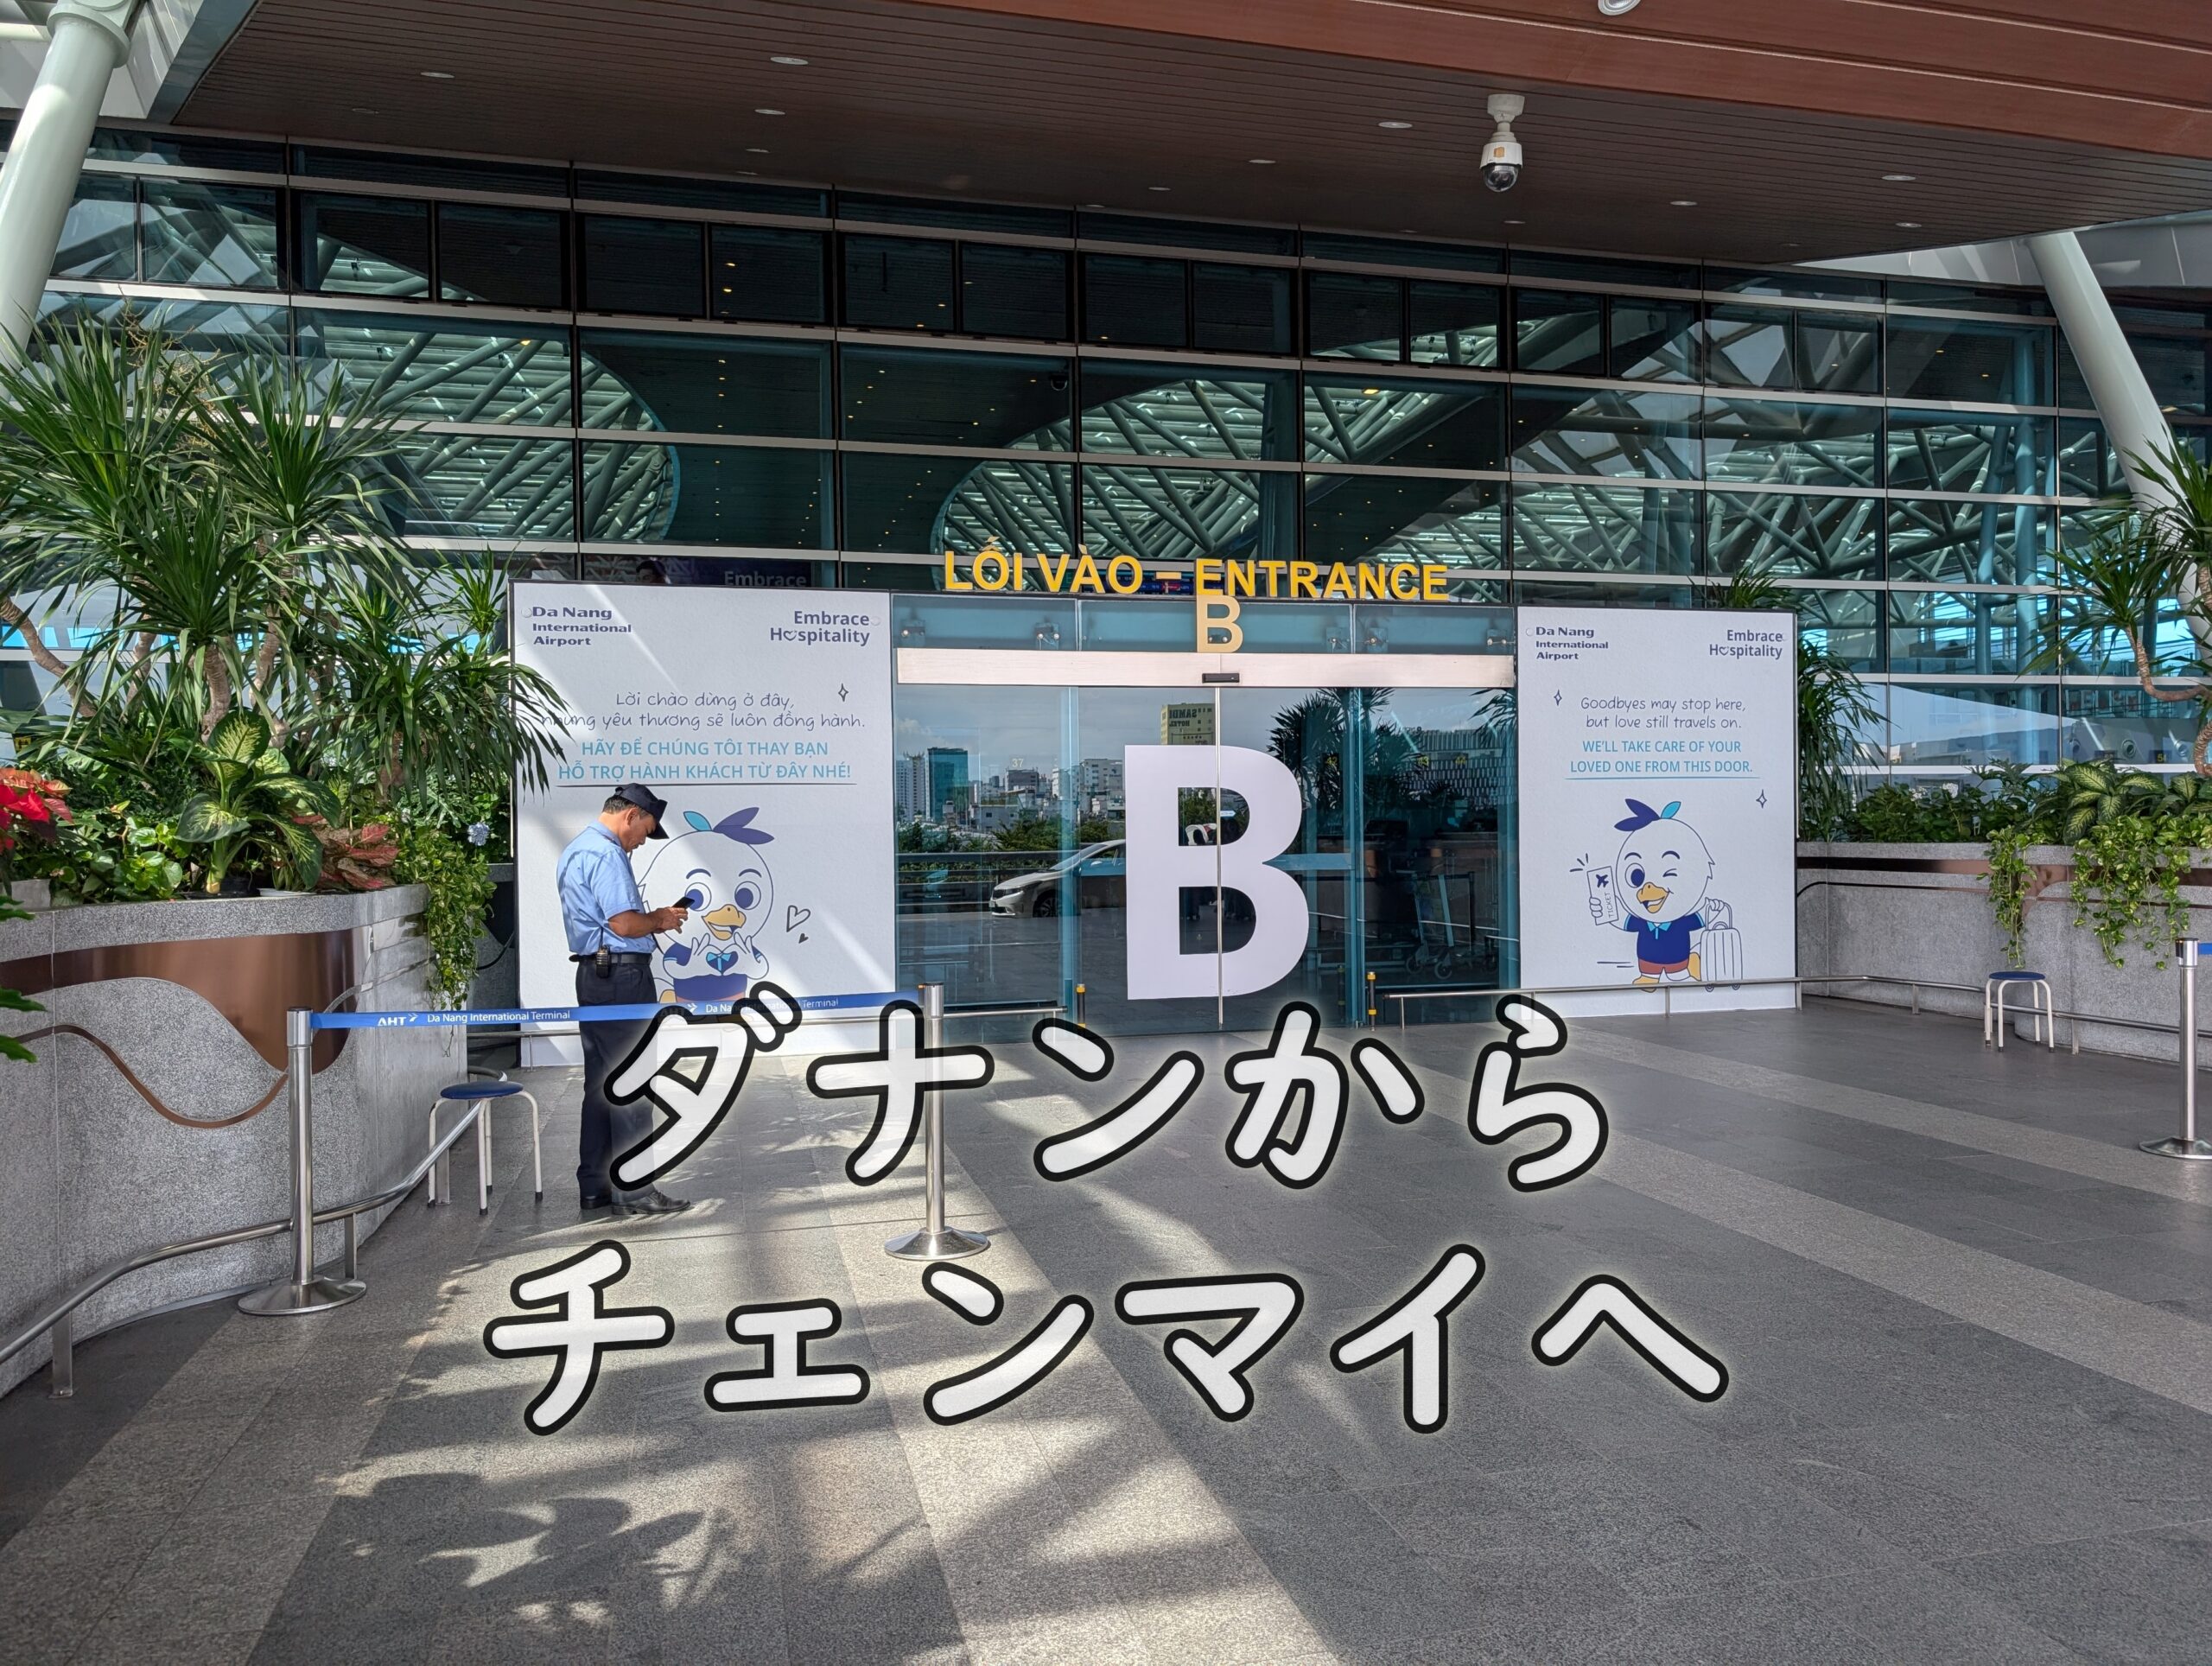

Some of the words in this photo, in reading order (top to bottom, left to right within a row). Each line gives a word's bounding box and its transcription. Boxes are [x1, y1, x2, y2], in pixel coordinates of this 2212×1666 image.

[945, 537, 1023, 591] LỐI
[1037, 544, 1143, 595] VÀO
[1196, 558, 1449, 601] ENTRANCE
[532, 607, 558, 617] Da
[563, 607, 613, 620] Nang
[794, 610, 870, 626] Embrace
[532, 623, 632, 633] International
[1197, 595, 1243, 653] B
[1535, 626, 1555, 636] Da
[1558, 627, 1595, 638] Nang
[1726, 629, 1783, 642] Embrace
[533, 636, 592, 646] Airport
[1535, 640, 1609, 649] International
[1536, 652, 1580, 661] Airport
[616, 691, 640, 705] Lời
[647, 692, 689, 706] chào
[695, 692, 737, 711] dừng
[743, 692, 754, 707] ở
[760, 693, 794, 711] đây,
[1580, 696, 1645, 713] Goodbyes
[1651, 700, 1676, 712] may
[1681, 697, 1711, 711] stop
[1715, 697, 1746, 712] here,
[602, 713, 632, 729] yêu
[639, 712, 700, 730] thương
[706, 713, 723, 727] sẽ
[731, 713, 767, 727] luôn
[773, 710, 815, 731] đồng
[821, 714, 865, 728] hành.
[1586, 715, 1609, 728] but
[1615, 715, 1640, 728] love
[1645, 715, 1669, 728] still
[1674, 716, 1716, 728] travels
[1720, 719, 1742, 728] on.
[582, 738, 615, 755] HÃY
[620, 736, 643, 755] ĐỂ
[648, 738, 709, 755] CHÚNG
[714, 738, 743, 755] TÔI
[747, 742, 790, 755] THAY
[794, 742, 829, 759] BẠN
[1583, 741, 1618, 752] WE'LL
[1621, 741, 1651, 753] TAKE
[1655, 741, 1685, 753] CARE
[1688, 741, 1705, 753] OF
[1708, 741, 1741, 753] YOUR
[1012, 758, 1024, 768] 37
[1570, 761, 1611, 772] LOVED
[1615, 761, 1642, 773] ONE
[1645, 761, 1680, 772] FROM
[1684, 761, 1711, 773] THIS
[1714, 761, 1753, 773] DOOR.
[559, 760, 585, 779] HỖ
[590, 765, 625, 782] TRỢ
[631, 762, 680, 779] HÀNH
[686, 761, 743, 779] KHÁCH
[748, 761, 772, 778] TỪ
[776, 761, 808, 778] ĐÂY
[813, 761, 851, 778] NHÉ!
[1125, 745, 1309, 1000] B
[1605, 892, 1614, 918] TICKET
[804, 1000, 838, 1009] Terminal
[378, 1017, 406, 1027] AHT
[428, 1014, 440, 1022] Da
[442, 1014, 467, 1023] Nang
[470, 1011, 529, 1021] International
[531, 1010, 570, 1020] Terminal
